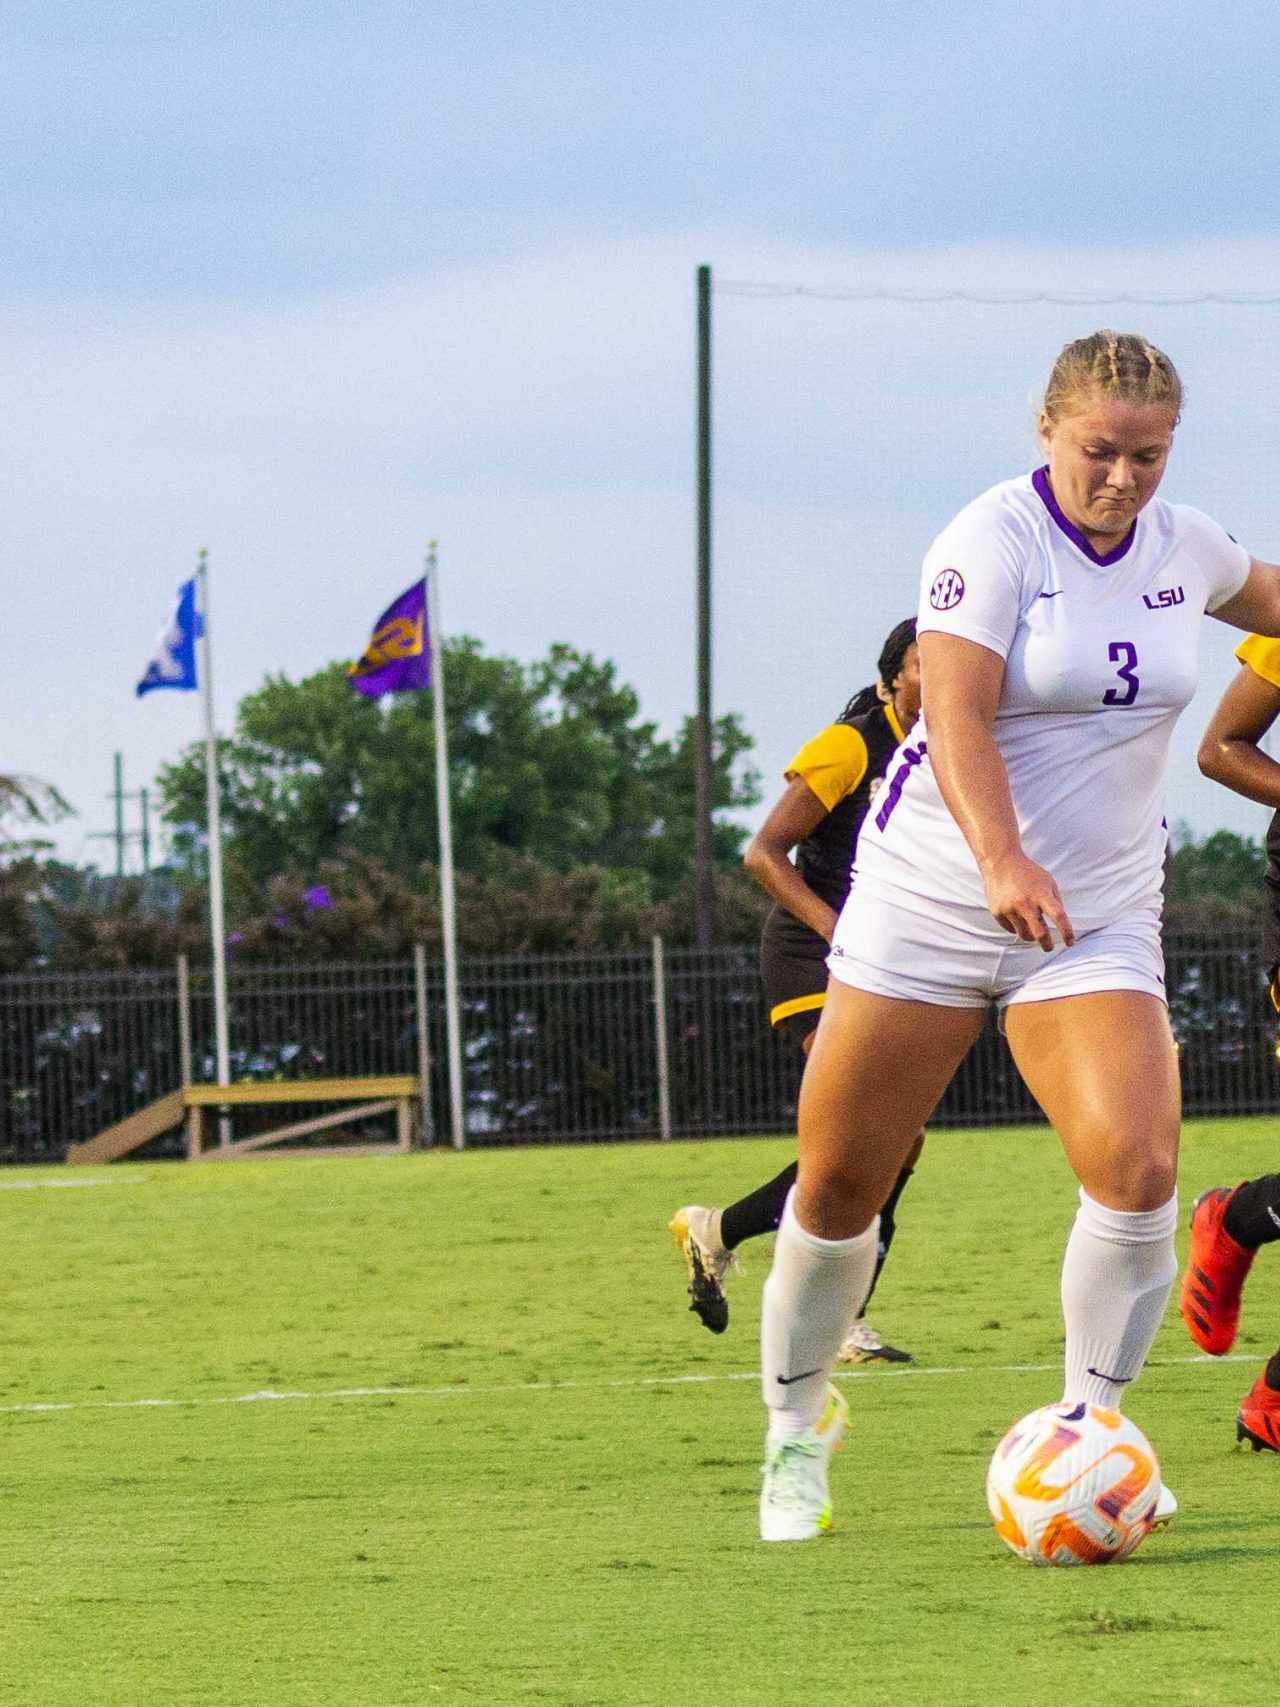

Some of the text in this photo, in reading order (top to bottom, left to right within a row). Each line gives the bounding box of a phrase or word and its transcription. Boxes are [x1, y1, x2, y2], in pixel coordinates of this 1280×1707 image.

[930, 569, 964, 610] SEC
[1143, 586, 1185, 610] LSU
[1102, 641, 1139, 705] 3
